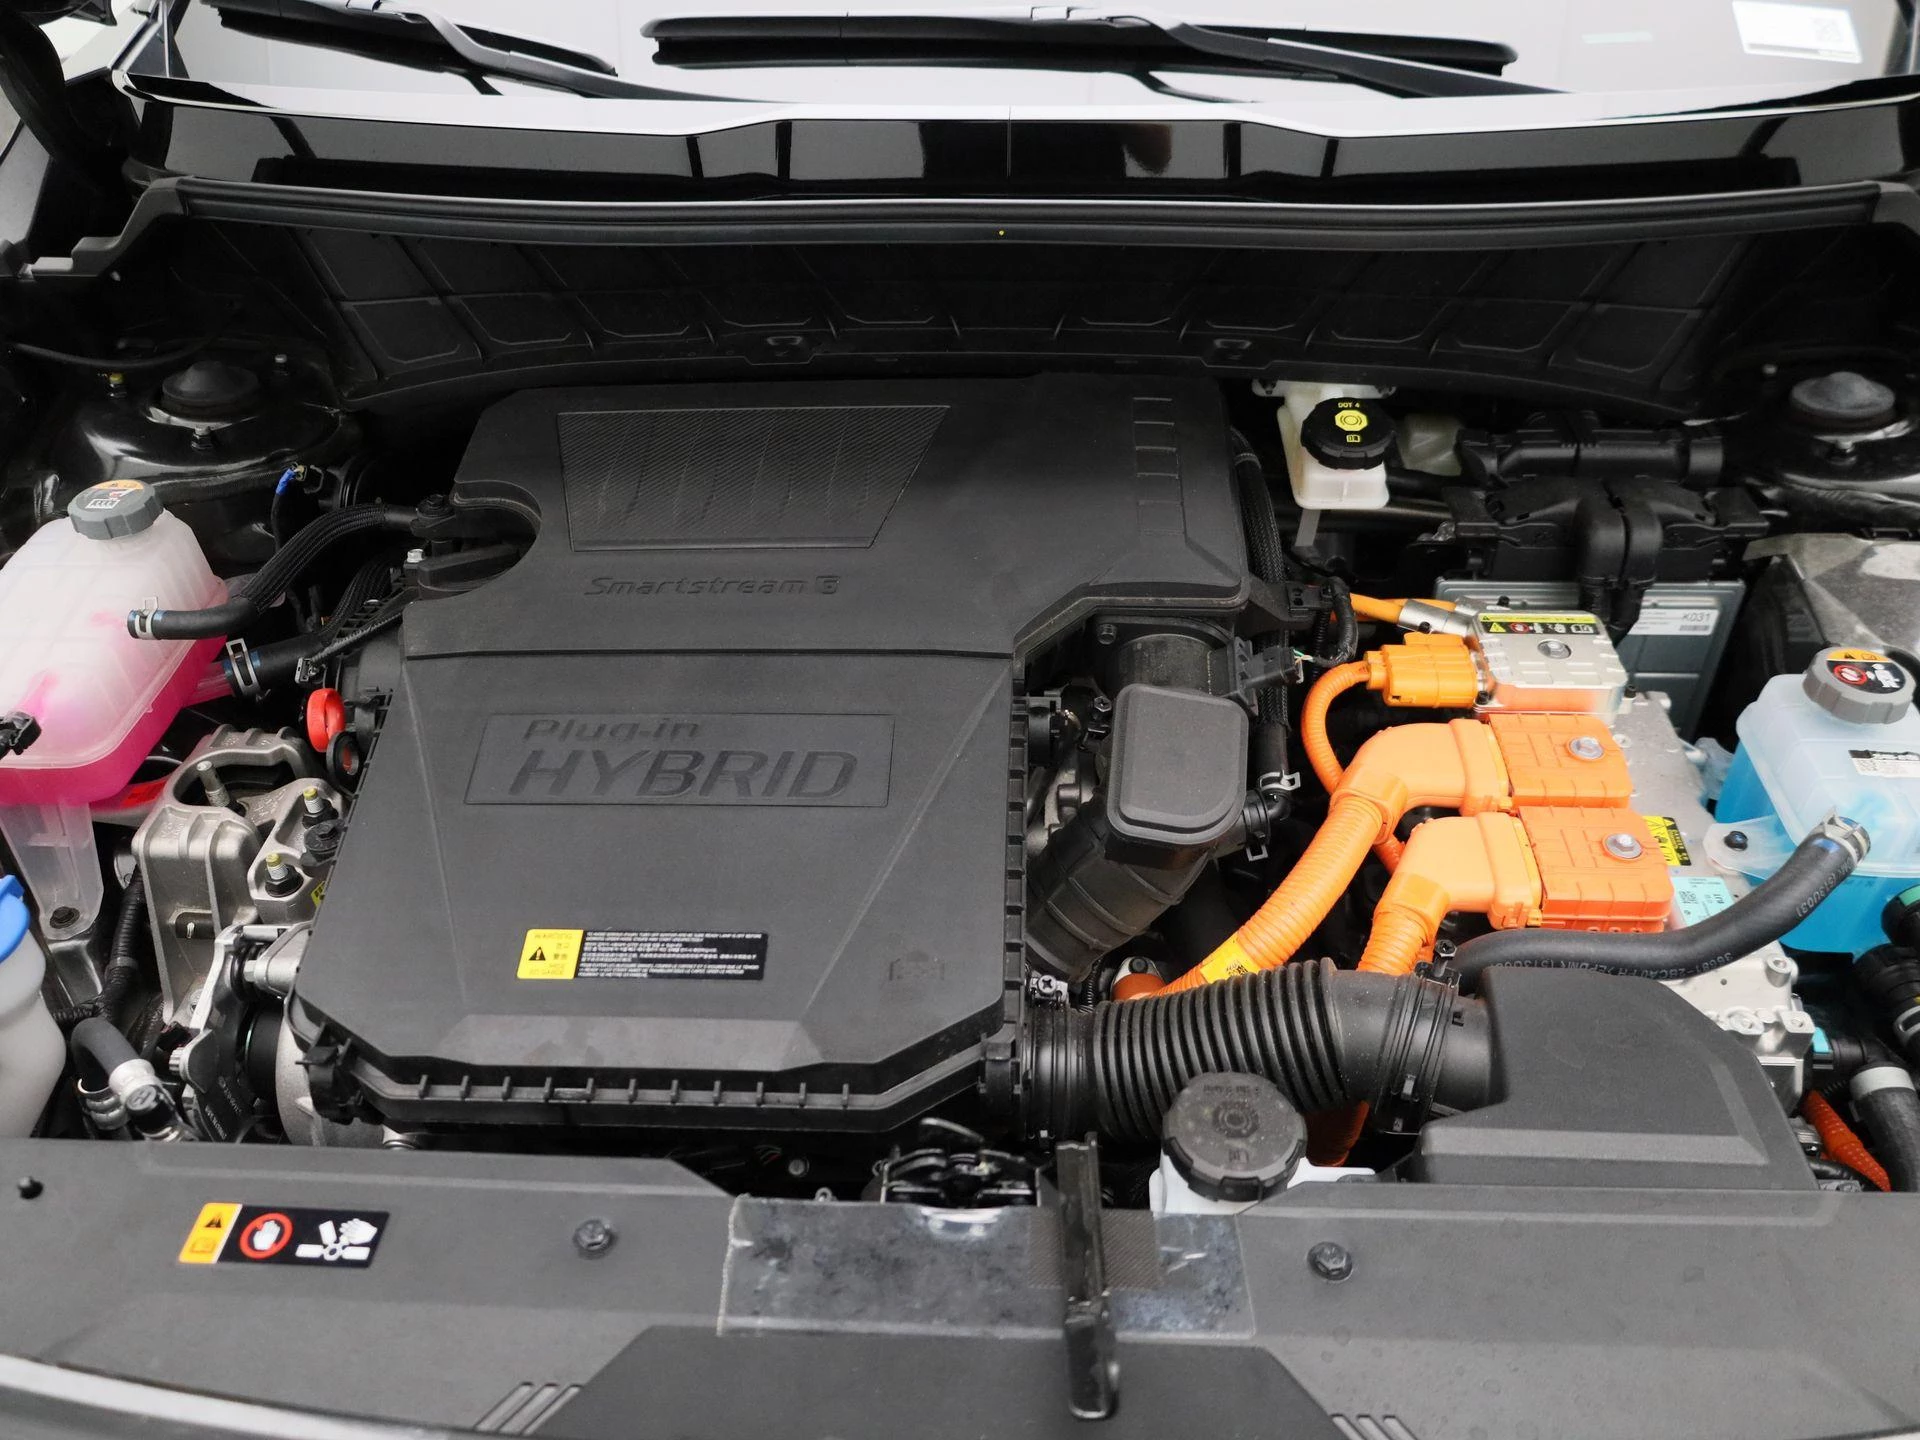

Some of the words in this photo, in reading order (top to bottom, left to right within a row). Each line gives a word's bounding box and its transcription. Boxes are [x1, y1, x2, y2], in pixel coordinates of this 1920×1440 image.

[584, 576, 808, 595] Smartstream
[523, 716, 700, 744] Plug-in
[507, 748, 859, 799] HYBRID
